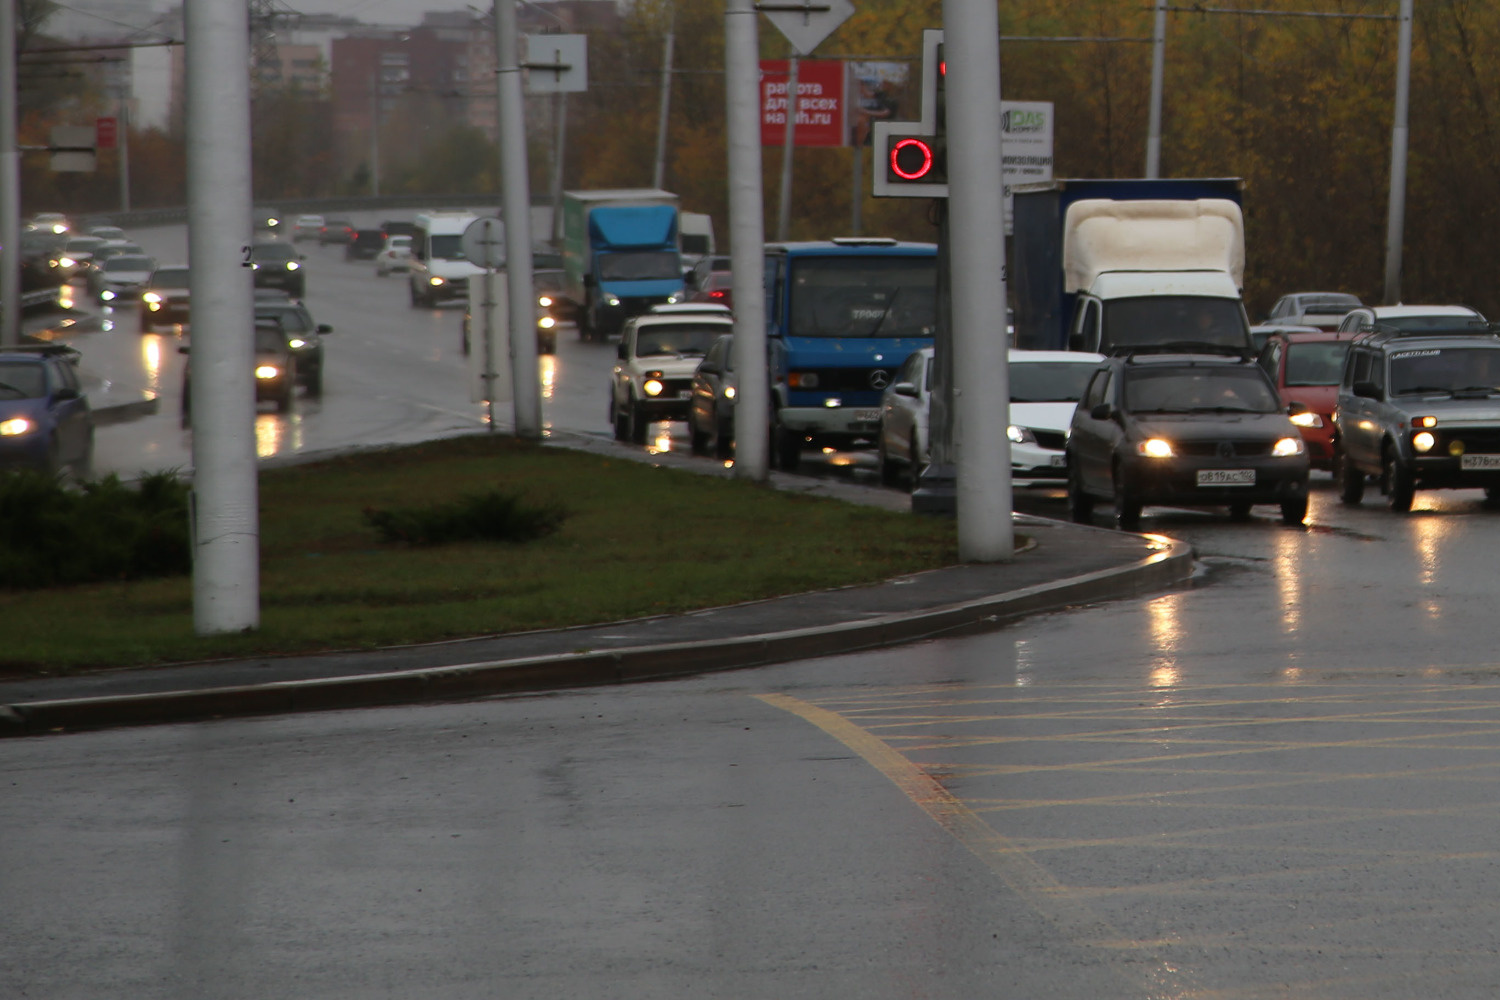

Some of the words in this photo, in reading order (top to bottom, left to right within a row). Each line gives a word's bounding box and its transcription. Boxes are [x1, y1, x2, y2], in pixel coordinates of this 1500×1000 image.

[766, 99, 790, 111] дл
[799, 99, 838, 110] всех
[765, 113, 786, 124] на
